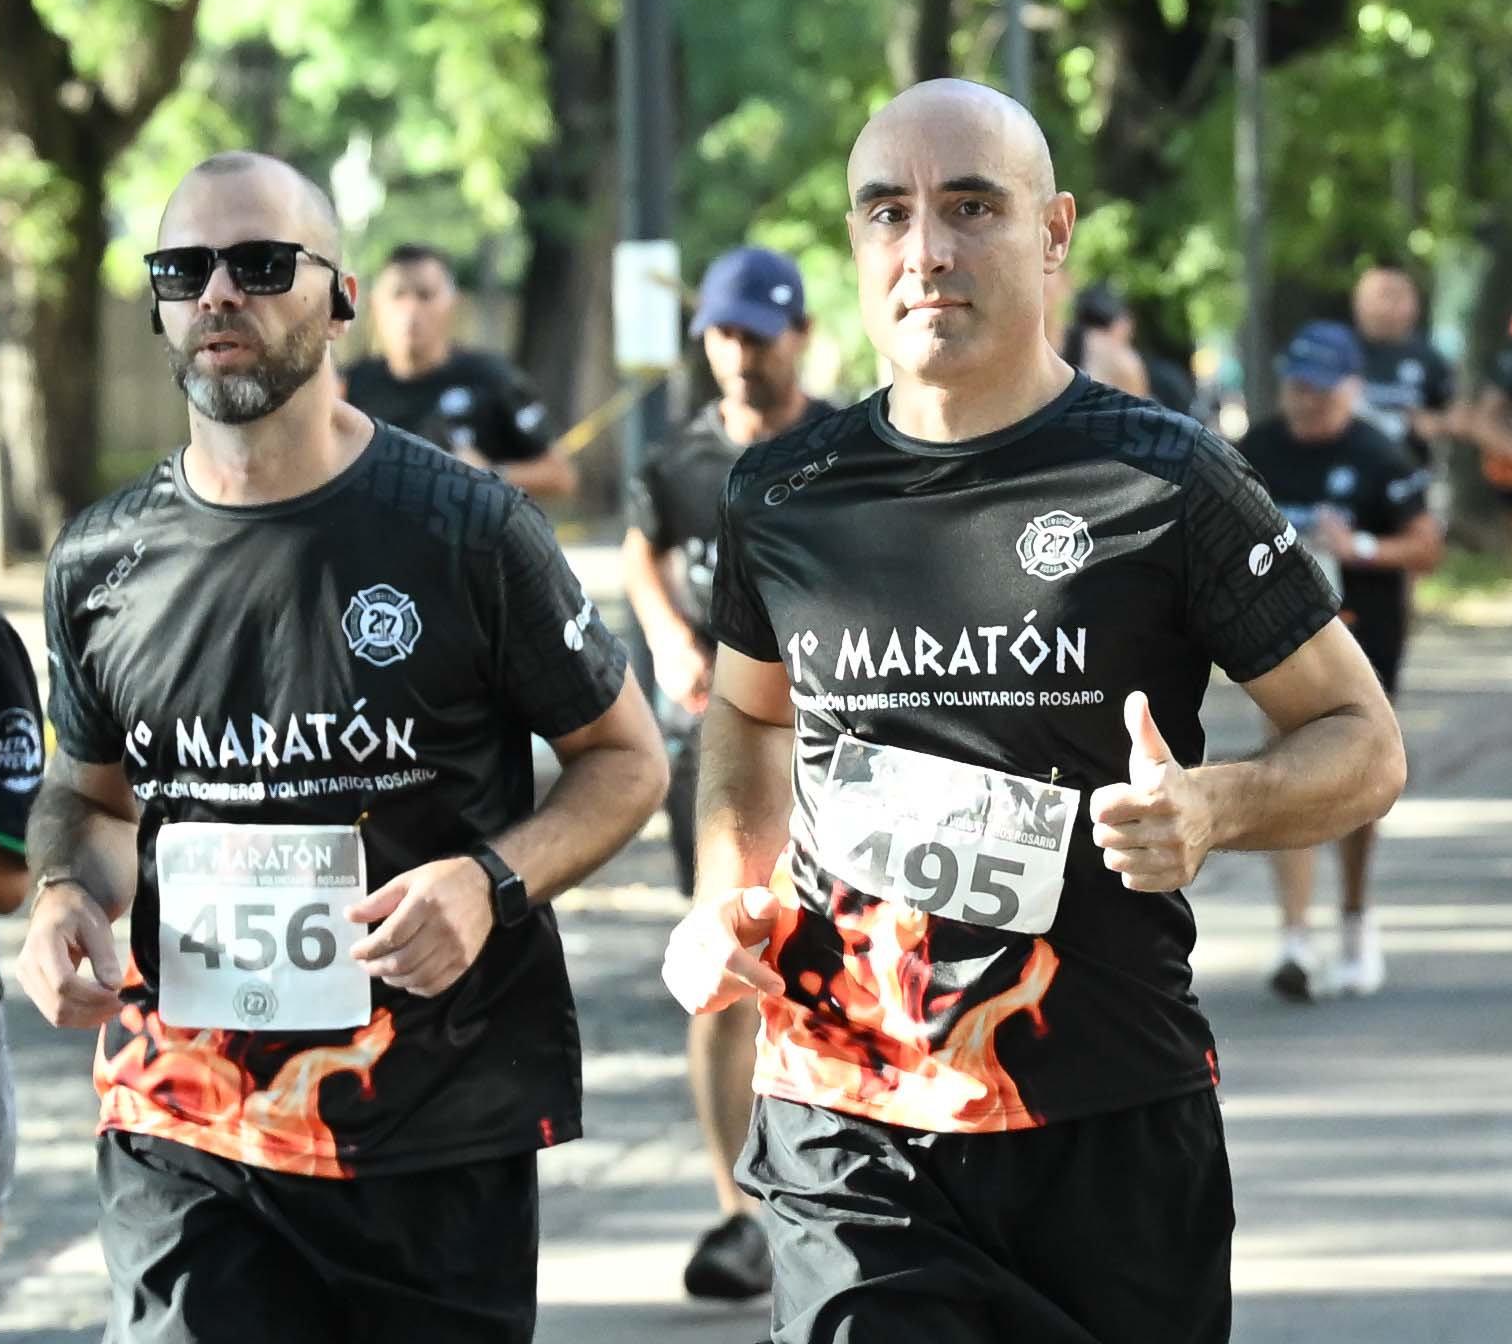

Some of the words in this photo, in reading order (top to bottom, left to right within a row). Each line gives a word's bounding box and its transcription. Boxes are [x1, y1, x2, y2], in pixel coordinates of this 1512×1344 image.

[835, 609, 1086, 680] MARATÓN
[847, 692, 930, 712] BOMBEROS
[933, 690, 1035, 708] VOLUNTARIOS
[1039, 690, 1104, 706] ROSARIO
[176, 698, 416, 768] MARATÓN
[268, 776, 372, 799] VOLUNTARIOS
[375, 767, 436, 792] ROSARIO
[210, 838, 331, 871] MARATÓN
[1015, 831, 1056, 850] ROSARIO
[180, 902, 336, 971] 456
